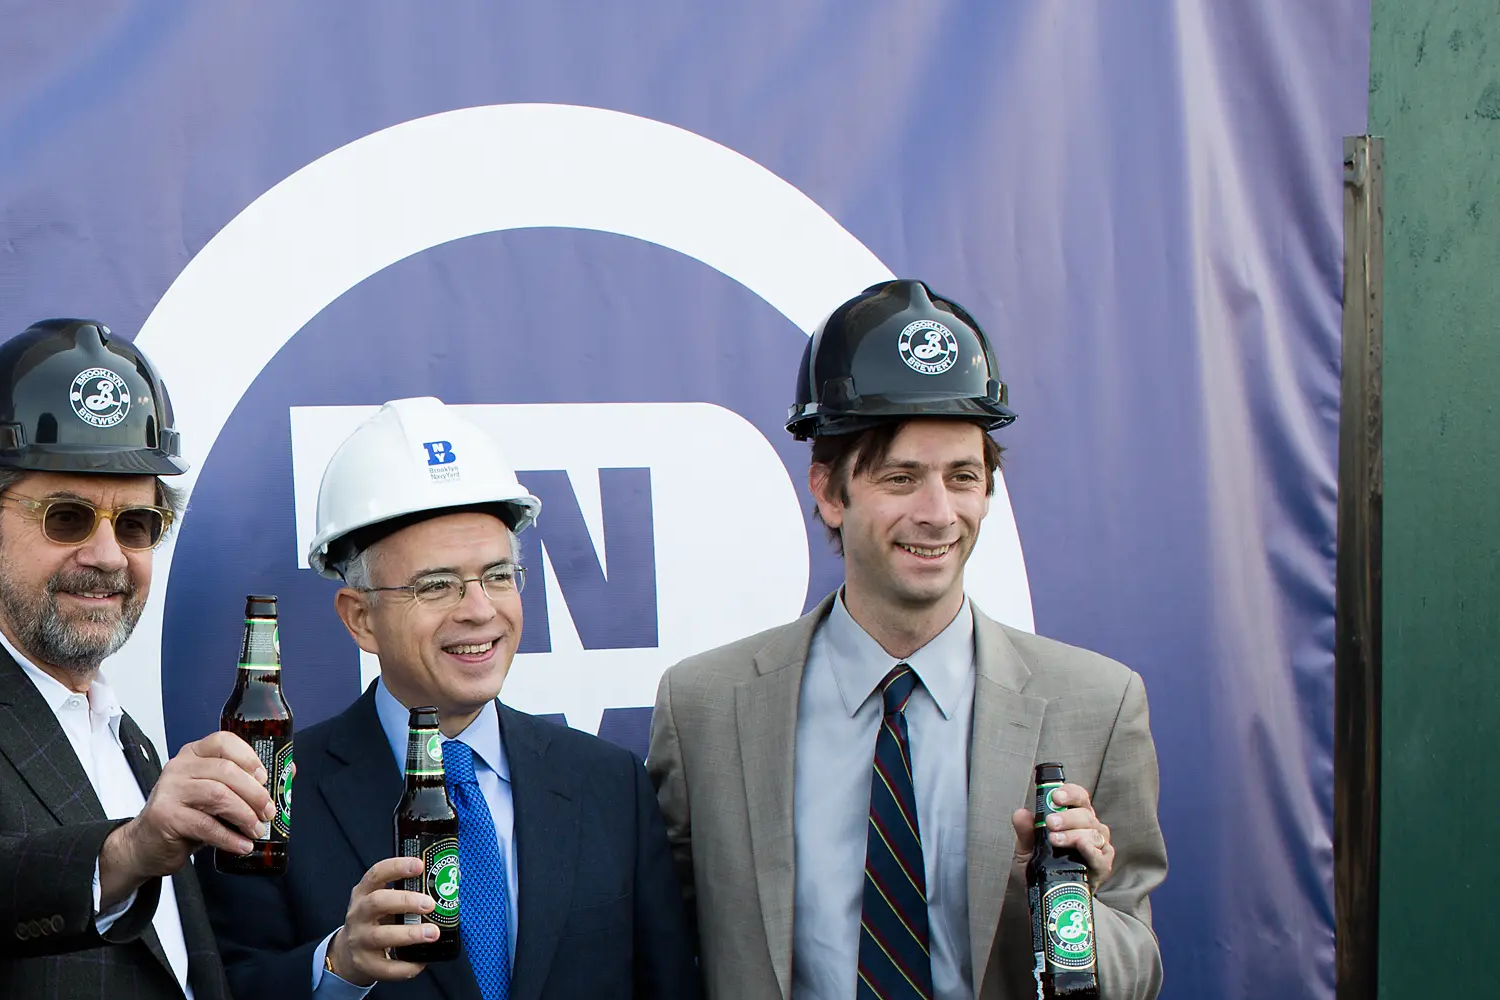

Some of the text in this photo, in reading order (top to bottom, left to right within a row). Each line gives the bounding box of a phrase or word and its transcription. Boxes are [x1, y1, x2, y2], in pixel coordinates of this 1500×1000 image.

[903, 321, 951, 337] BROOKLYN
[908, 356, 952, 373] BREWERY
[76, 369, 124, 387] BROOKLYN
[78, 408, 124, 426] BREWERY
[429, 466, 459, 474] Brooklyn
[432, 857, 459, 876] BROOK
[437, 897, 460, 908] LAGE
[1058, 941, 1089, 951] LAGER
